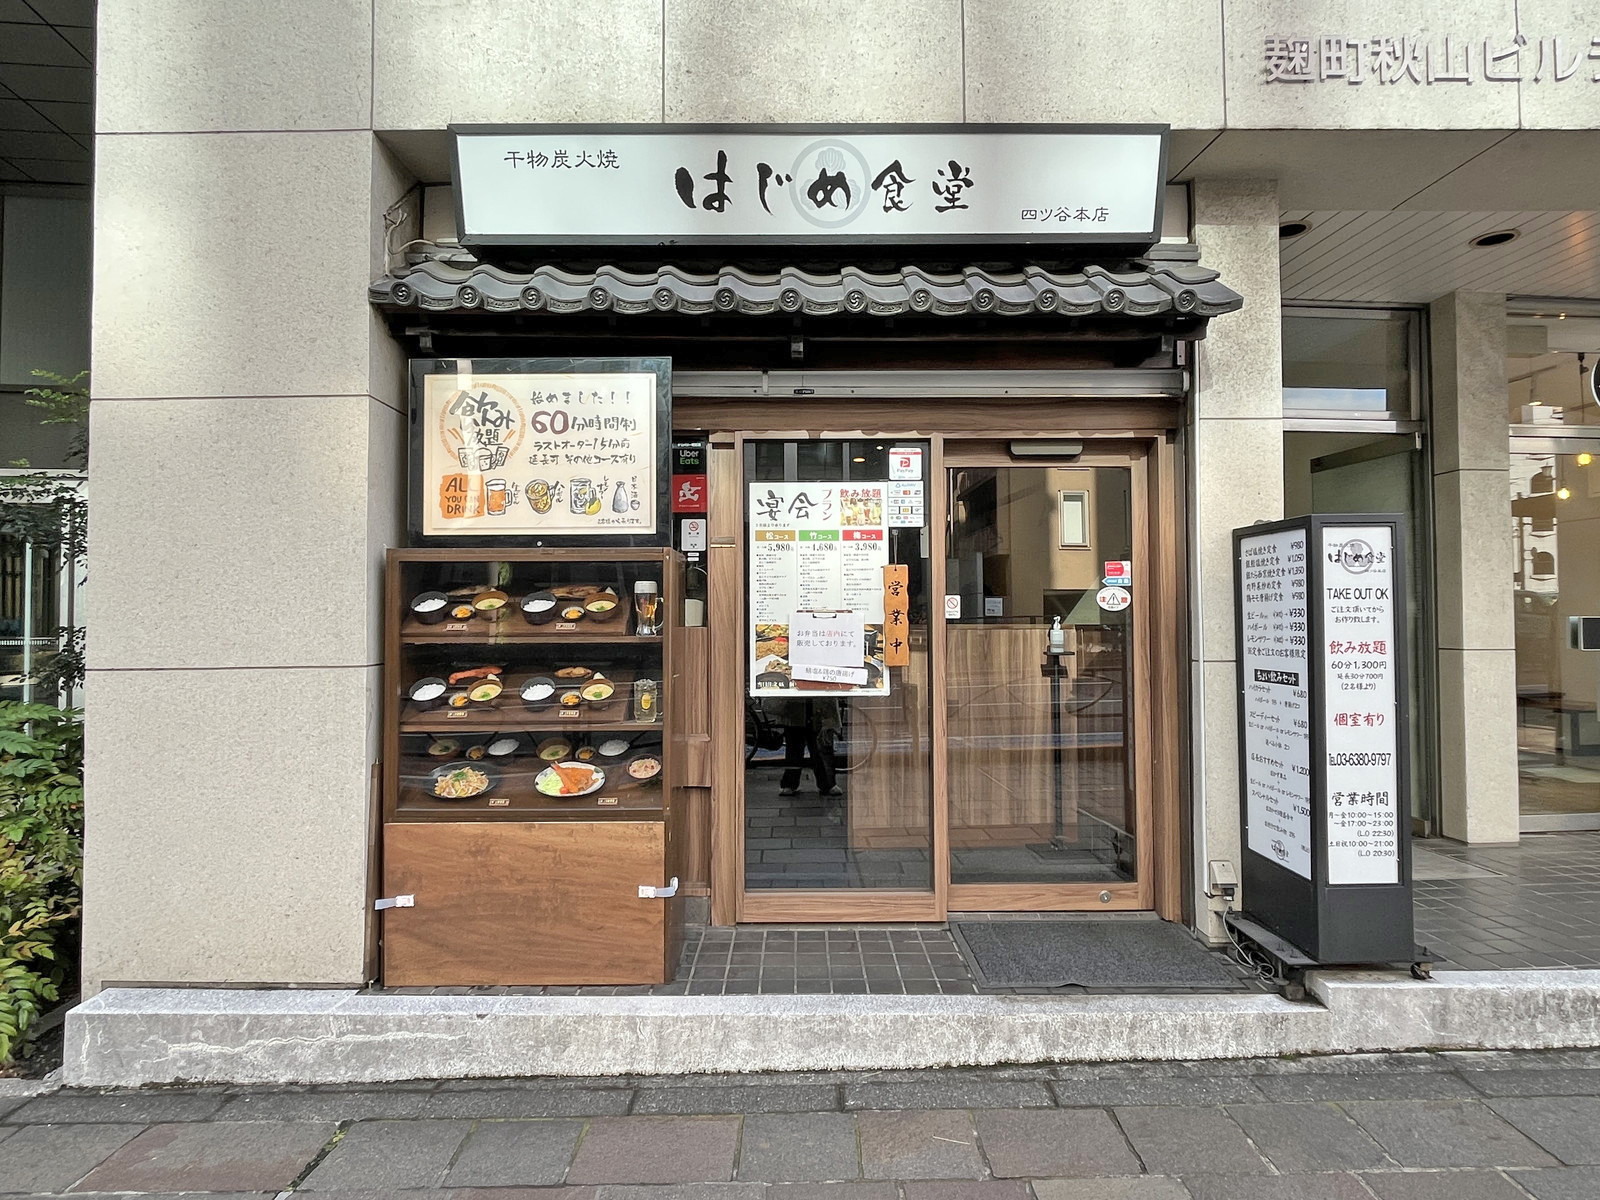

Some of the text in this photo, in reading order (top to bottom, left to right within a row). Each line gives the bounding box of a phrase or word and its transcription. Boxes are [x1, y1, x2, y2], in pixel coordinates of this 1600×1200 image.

[503, 149, 621, 170] 干物炭火焼
[674, 149, 974, 215] はじめ食堂
[1020, 206, 1110, 223] 四ツ谷本店
[531, 410, 637, 435] 60分時間制
[534, 437, 631, 451] ラストオーダー15分前
[680, 457, 700, 465] Eats
[445, 495, 462, 504] YOU
[840, 488, 881, 498] 飲み放題
[447, 504, 480, 515] DRINK
[757, 489, 818, 521] 宴会
[822, 488, 832, 521] プラン
[765, 532, 789, 540] 松コース
[809, 532, 832, 540] 竹コース
[853, 532, 876, 540] 梅コース
[1328, 549, 1386, 563] はじめ食堂
[1327, 588, 1389, 600] TAKE OUT OK
[888, 581, 904, 654] 営業中
[1289, 608, 1305, 618] ¥330
[1290, 622, 1305, 632] ¥330
[796, 640, 857, 648] 販売しております。
[1290, 636, 1305, 646] ¥330
[1329, 641, 1387, 655] 飲み放題
[1331, 661, 1387, 669] 60分1,300円
[1257, 670, 1297, 685] ちょい飲みセット
[1334, 712, 1385, 727] 個室有り
[1331, 791, 1389, 806] 営業時間
